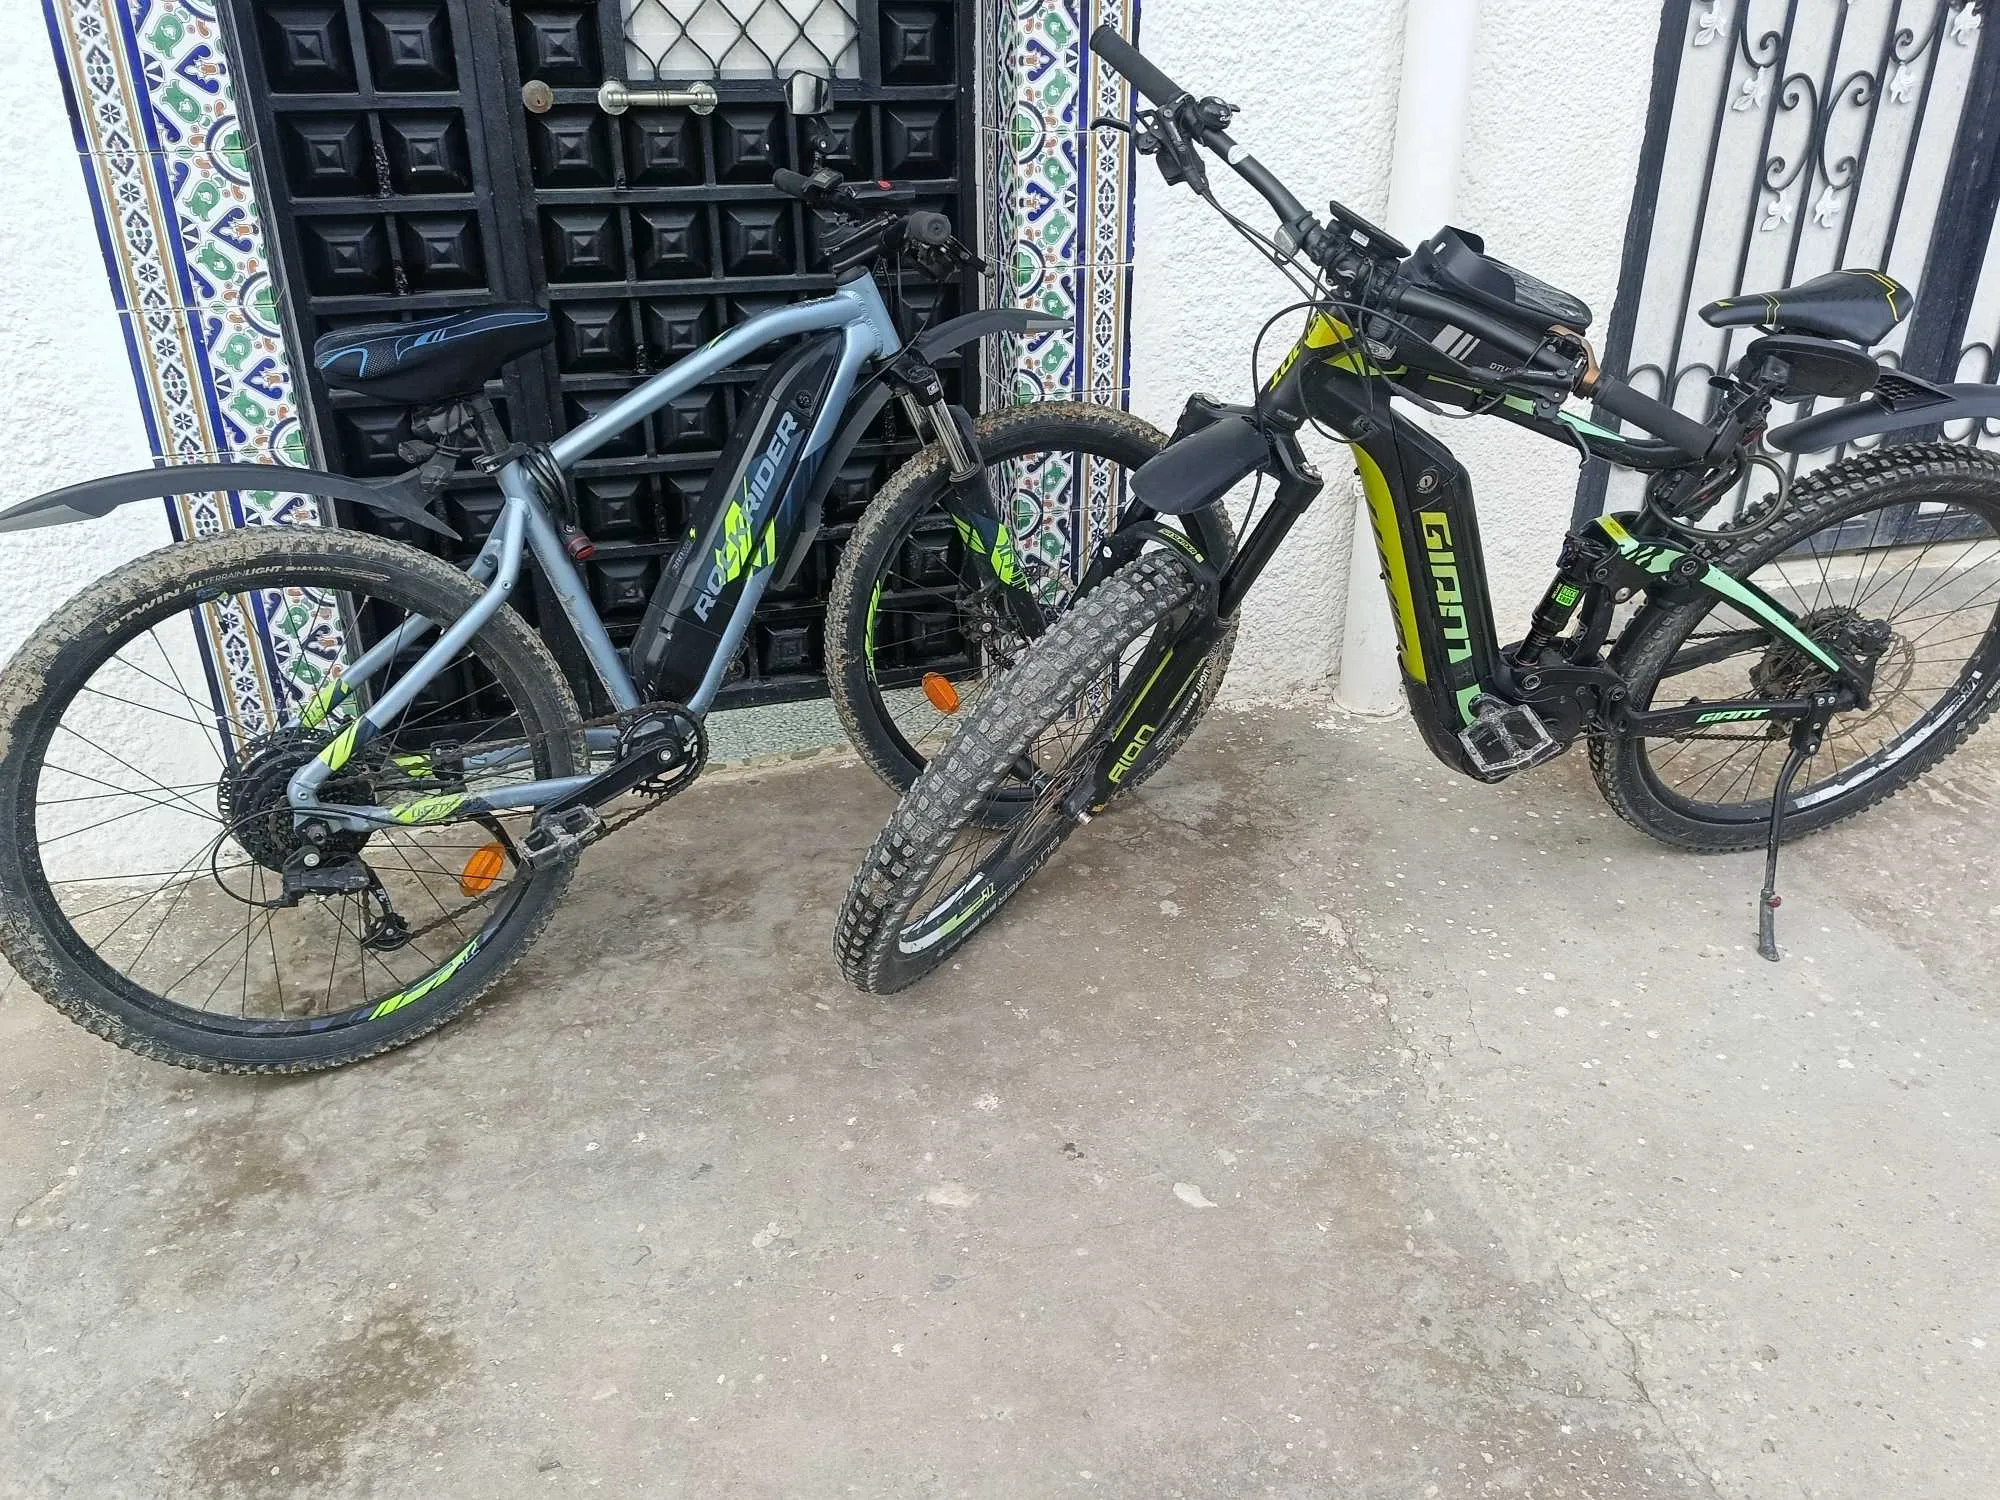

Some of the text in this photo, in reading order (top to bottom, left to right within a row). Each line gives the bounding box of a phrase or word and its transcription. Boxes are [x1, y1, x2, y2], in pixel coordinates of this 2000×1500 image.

[692, 410, 799, 623] ROCKRIDER
[1419, 511, 1473, 664] GIANT
[1695, 708, 1771, 724] GIANT
